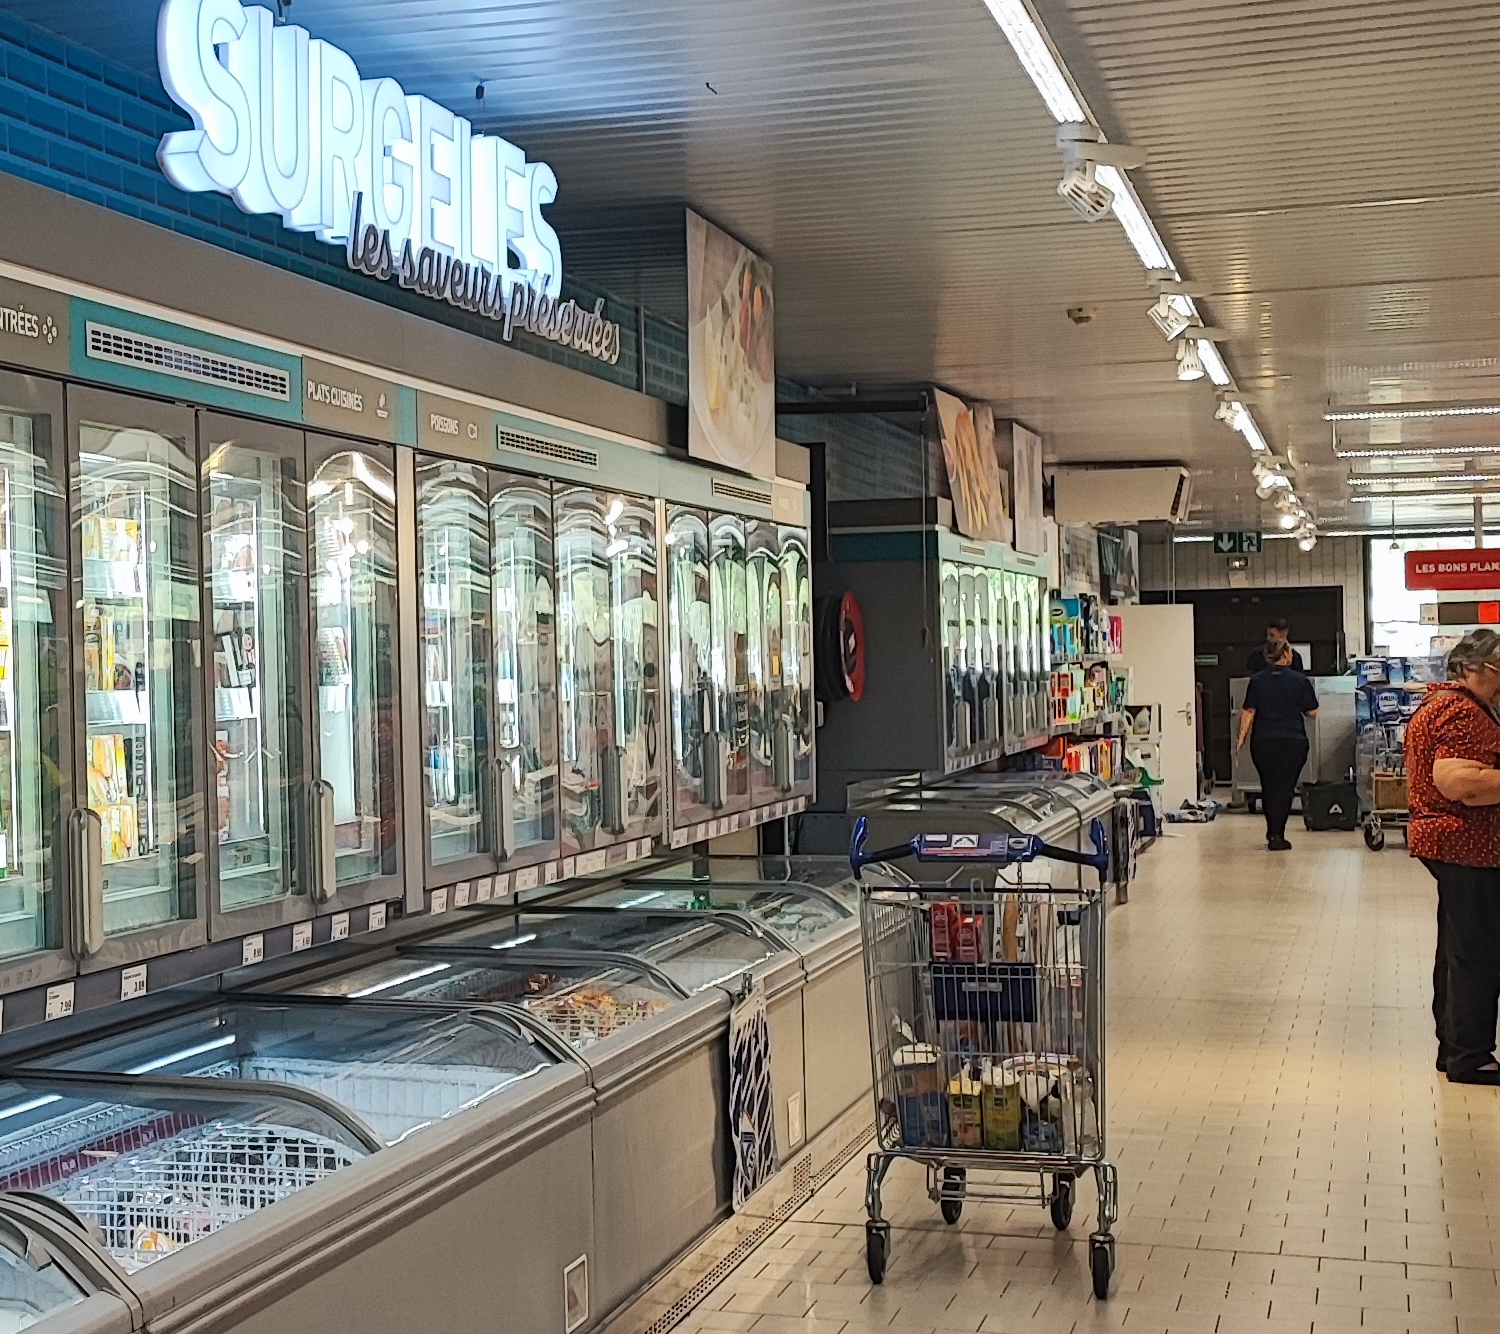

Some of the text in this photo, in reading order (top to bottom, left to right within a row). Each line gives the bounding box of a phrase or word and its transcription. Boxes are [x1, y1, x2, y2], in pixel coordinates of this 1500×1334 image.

[346, 190, 621, 365] les saveurs préservées
[307, 380, 363, 412] PLATS CUISINÉS
[430, 413, 459, 435] POISSONS
[1415, 561, 1500, 574] LES BONS PLAN
